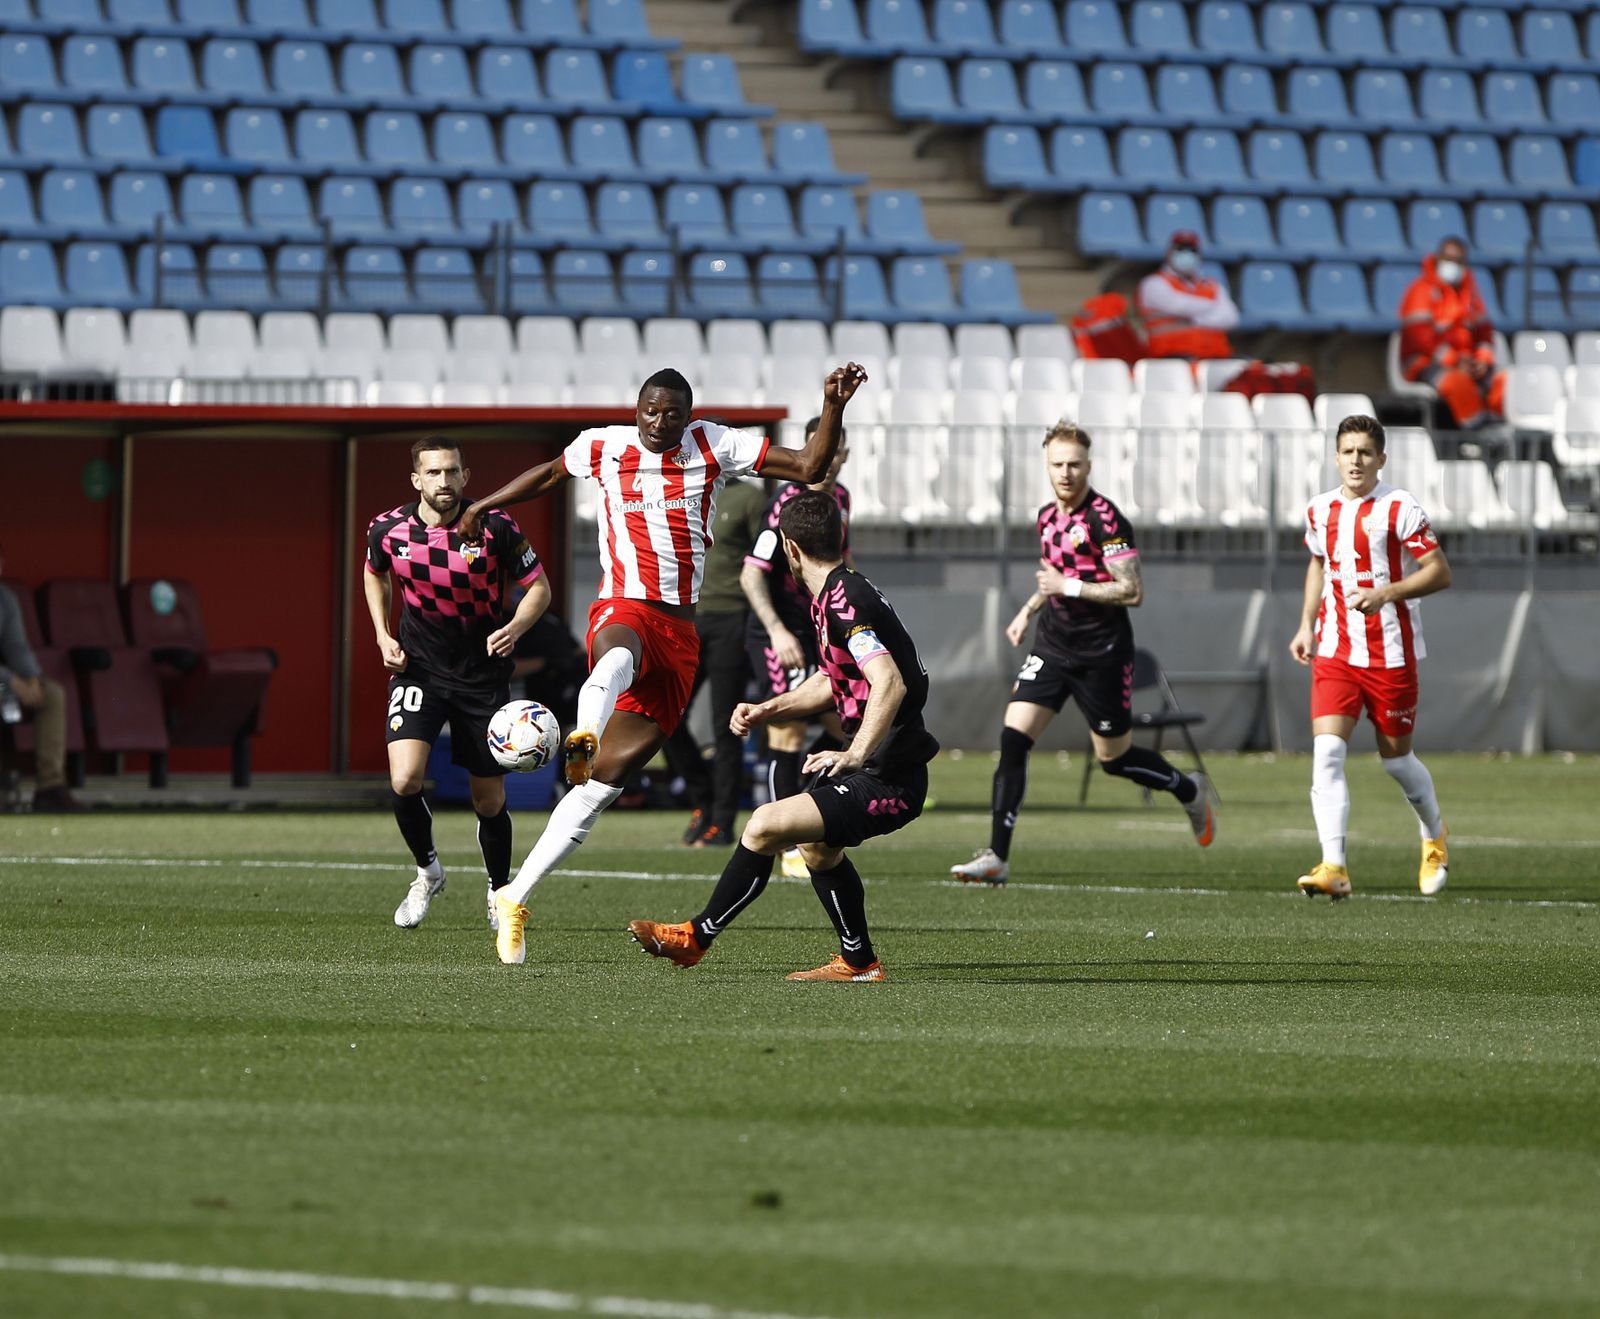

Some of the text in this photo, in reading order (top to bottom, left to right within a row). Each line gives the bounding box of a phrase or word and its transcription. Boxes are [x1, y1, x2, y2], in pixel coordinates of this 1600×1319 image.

[612, 498, 699, 514] Arabian Centres
[388, 685, 424, 717] 20
